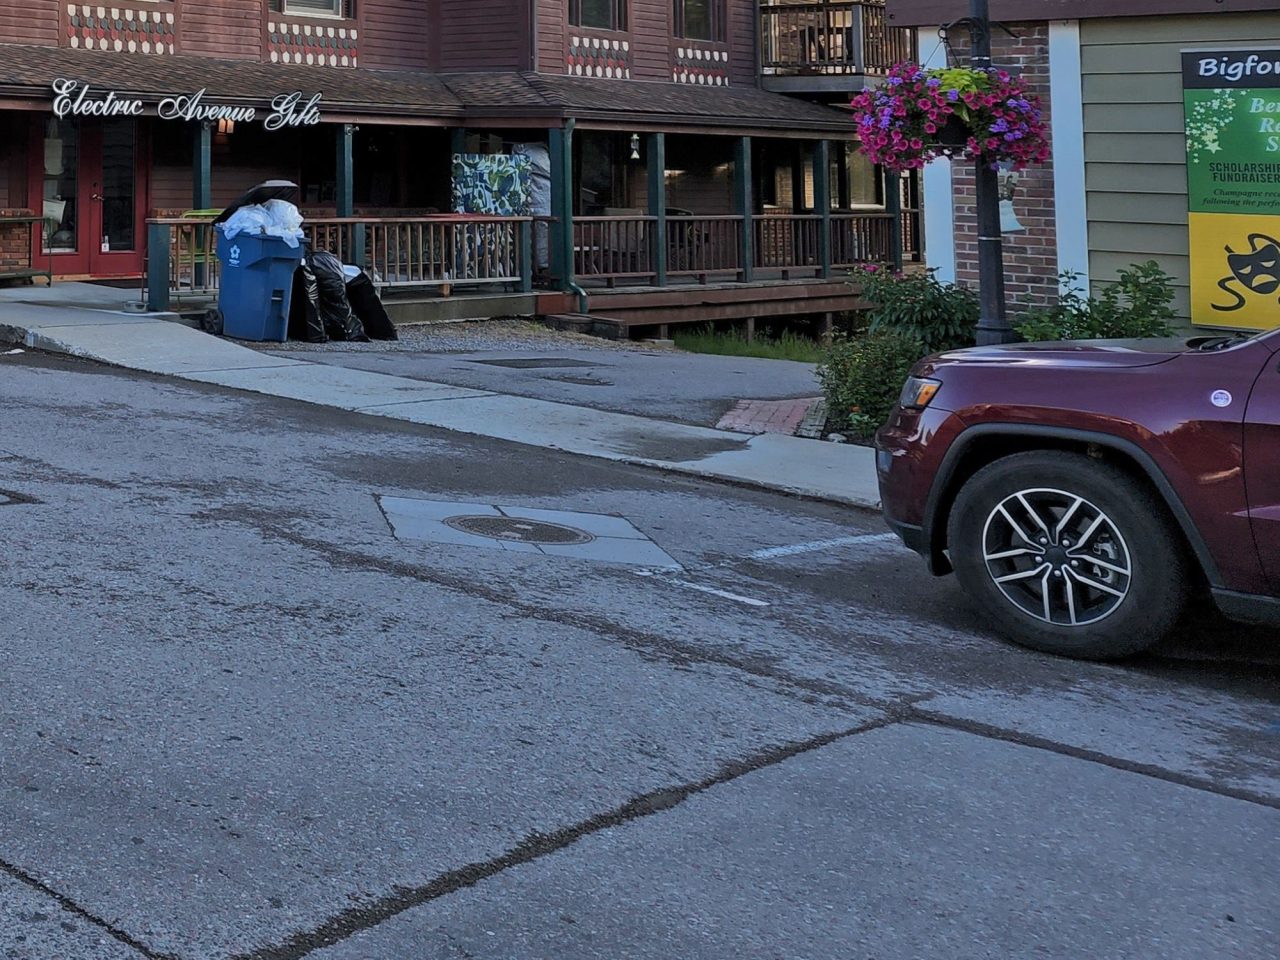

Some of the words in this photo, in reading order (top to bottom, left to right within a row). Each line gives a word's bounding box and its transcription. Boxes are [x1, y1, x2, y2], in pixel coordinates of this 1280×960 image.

[52, 78, 144, 120] Electric
[157, 87, 256, 122] Avenue
[264, 90, 322, 131] Gifts
[1265, 135, 1280, 152] S
[1212, 172, 1280, 183] FUNDRAISER
[1214, 188, 1263, 198] Champagne
